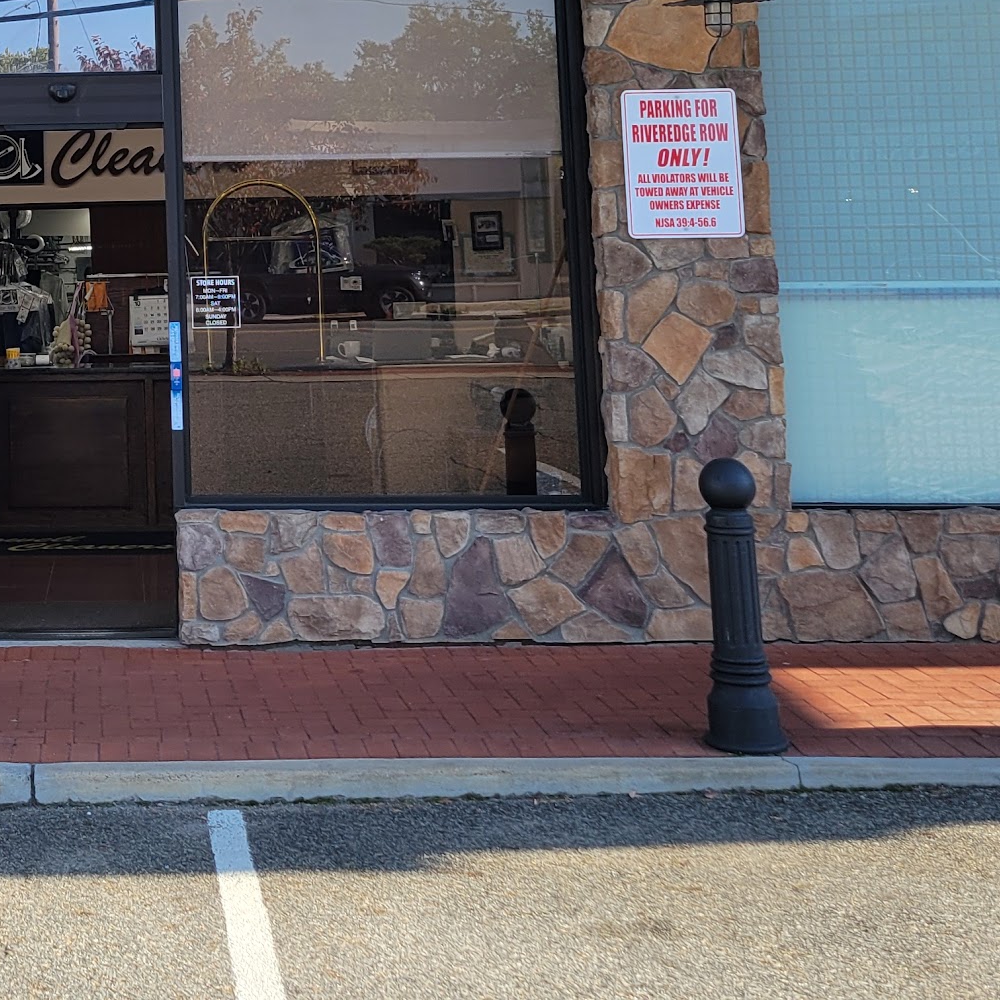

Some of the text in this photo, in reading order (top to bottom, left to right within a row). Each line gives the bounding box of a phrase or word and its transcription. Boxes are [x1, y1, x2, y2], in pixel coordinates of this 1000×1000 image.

[639, 98, 718, 118] PARKING FOR
[632, 123, 728, 143] RIVEREDGE ROW
[638, 172, 730, 184] ALL VIOLATORS WILL BE
[635, 186, 734, 197] TOWED AWAY AT VEHICLE
[650, 200, 721, 210] OWNERS EXPENSE
[655, 217, 717, 228] NJSA 39:4-56.6
